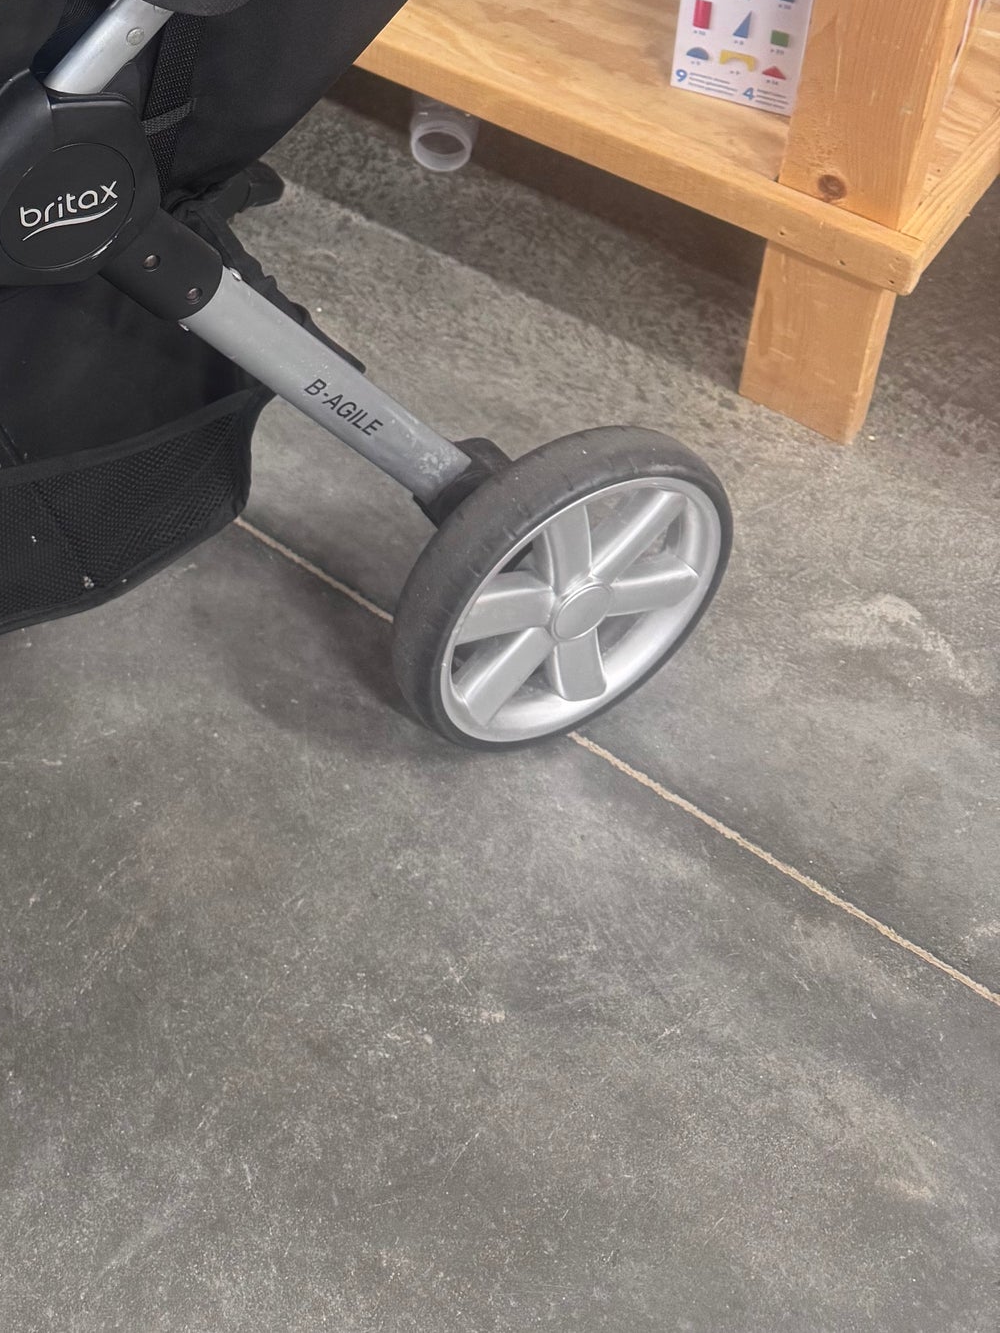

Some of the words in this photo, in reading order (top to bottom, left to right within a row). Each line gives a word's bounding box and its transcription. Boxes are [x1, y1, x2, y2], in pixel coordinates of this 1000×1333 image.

[675, 69, 688, 82] 9
[742, 87, 755, 101] 4
[20, 180, 118, 227] britax
[304, 378, 384, 436] B-AGILE
